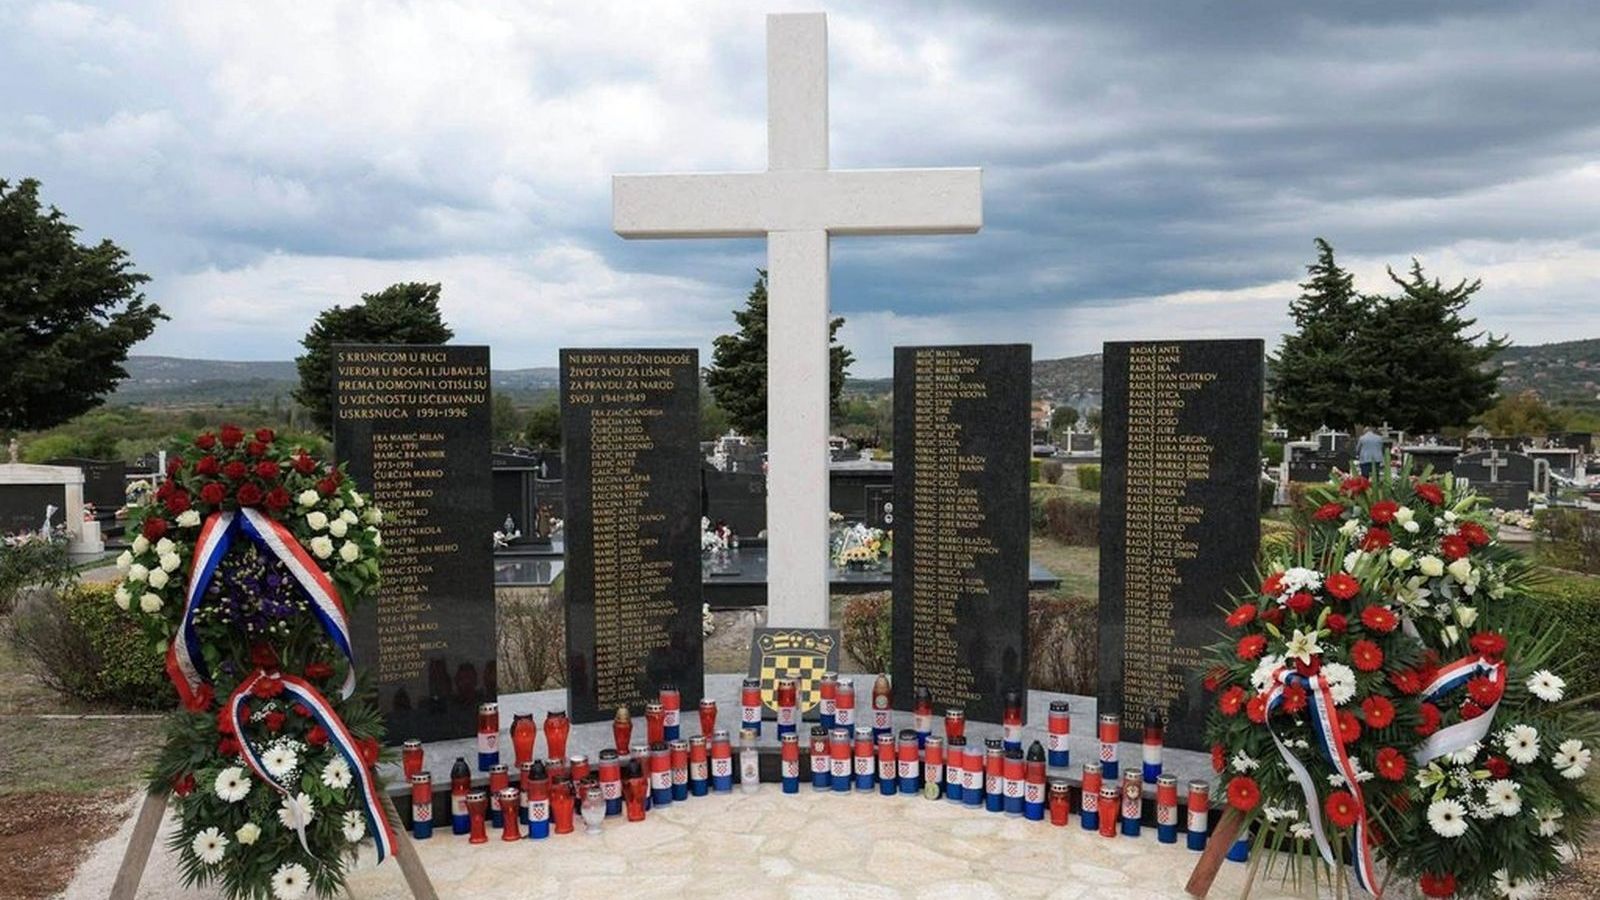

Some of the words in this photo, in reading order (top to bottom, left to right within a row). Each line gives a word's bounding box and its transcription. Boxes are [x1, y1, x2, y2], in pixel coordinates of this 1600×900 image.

[338, 352, 344, 362] S
[347, 352, 407, 362] KRUNICOM
[409, 352, 418, 362] U
[420, 352, 447, 362] RUCI
[569, 355, 580, 364] NI
[609, 355, 620, 364] NI
[622, 353, 652, 364] DUŽNI
[654, 353, 690, 364] DADOŠE
[338, 367, 379, 377] VJEROM
[382, 367, 390, 376] U
[393, 367, 423, 376] BOGA
[431, 366, 487, 376] LJUBAVLJU
[569, 366, 599, 377] ŽIVOT
[601, 367, 625, 377] SVOJ
[627, 367, 639, 377] ZA
[641, 366, 672, 376] LIŠANE
[338, 381, 374, 391] PREMA
[438, 379, 472, 390] OTIŠLI
[474, 380, 487, 390] SU
[569, 381, 583, 390] ZA
[626, 381, 638, 389] ZA
[640, 381, 674, 390] NAROD
[339, 395, 347, 405] U
[408, 394, 416, 404] U
[418, 393, 485, 404] IŠČEKIVANJU
[569, 394, 594, 404] SVOJ
[339, 408, 408, 419] USKRSNUĆA
[416, 407, 468, 418] 1991-1996
[373, 434, 388, 442] FRA
[413, 469, 443, 477] MARKO
[409, 526, 442, 535] NIKOLA
